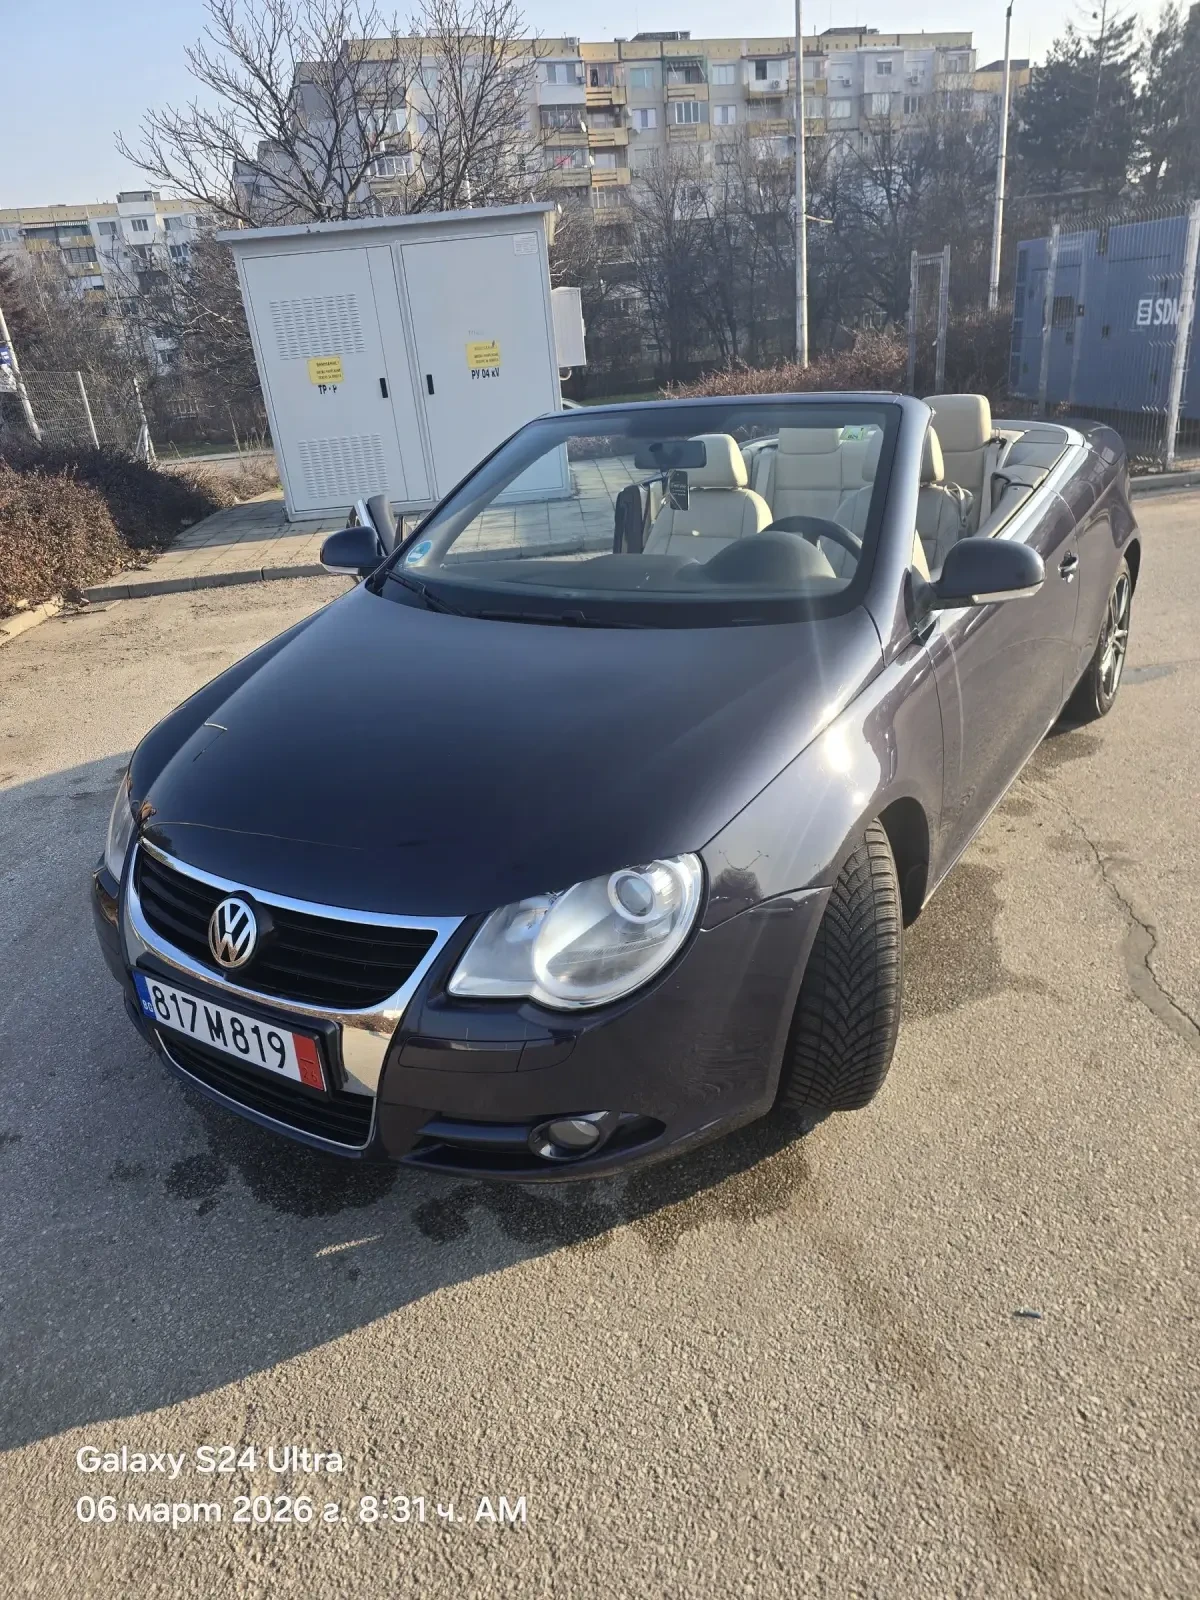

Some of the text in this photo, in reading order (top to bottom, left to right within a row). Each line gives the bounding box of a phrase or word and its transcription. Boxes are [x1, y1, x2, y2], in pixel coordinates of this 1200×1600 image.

[210, 899, 255, 966] VW
[142, 999, 154, 1013] BG
[152, 985, 286, 1069] 817M819
[303, 1065, 318, 1082] 26
